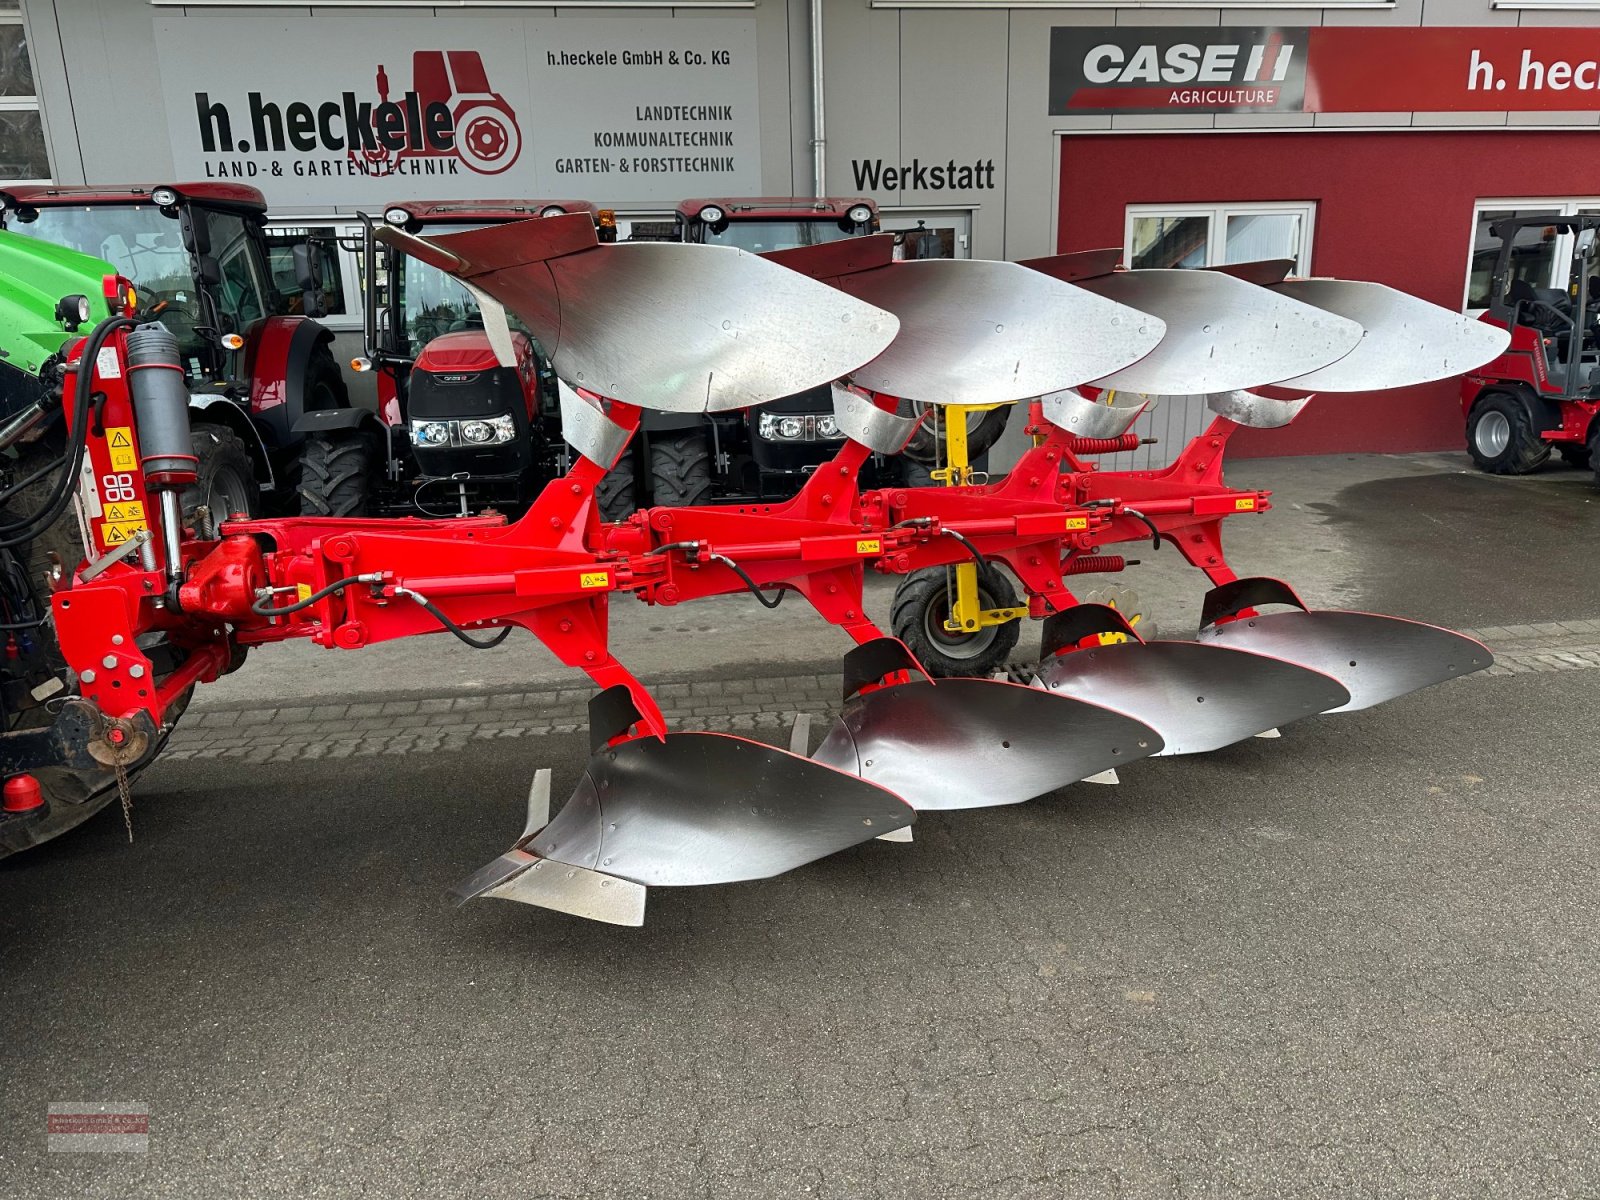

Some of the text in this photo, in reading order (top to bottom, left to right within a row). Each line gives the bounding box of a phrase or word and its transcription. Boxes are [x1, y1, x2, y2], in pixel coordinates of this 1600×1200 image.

[546, 50, 730, 65] h.heckele GmbH & Co. KG
[1083, 43, 1240, 83] CASE
[1467, 49, 1600, 91] h. hec
[1168, 90, 1274, 104] AGRICULTURE
[635, 105, 733, 121] LANDTECHNIK
[194, 91, 454, 153] h.heckele
[593, 131, 734, 147] KOMMUNALTECHNIK
[293, 159, 459, 177] GARTENTECHNIK
[555, 157, 735, 173] GARTEN- & FORSTTECHNIK
[851, 158, 995, 191] Werkstatt
